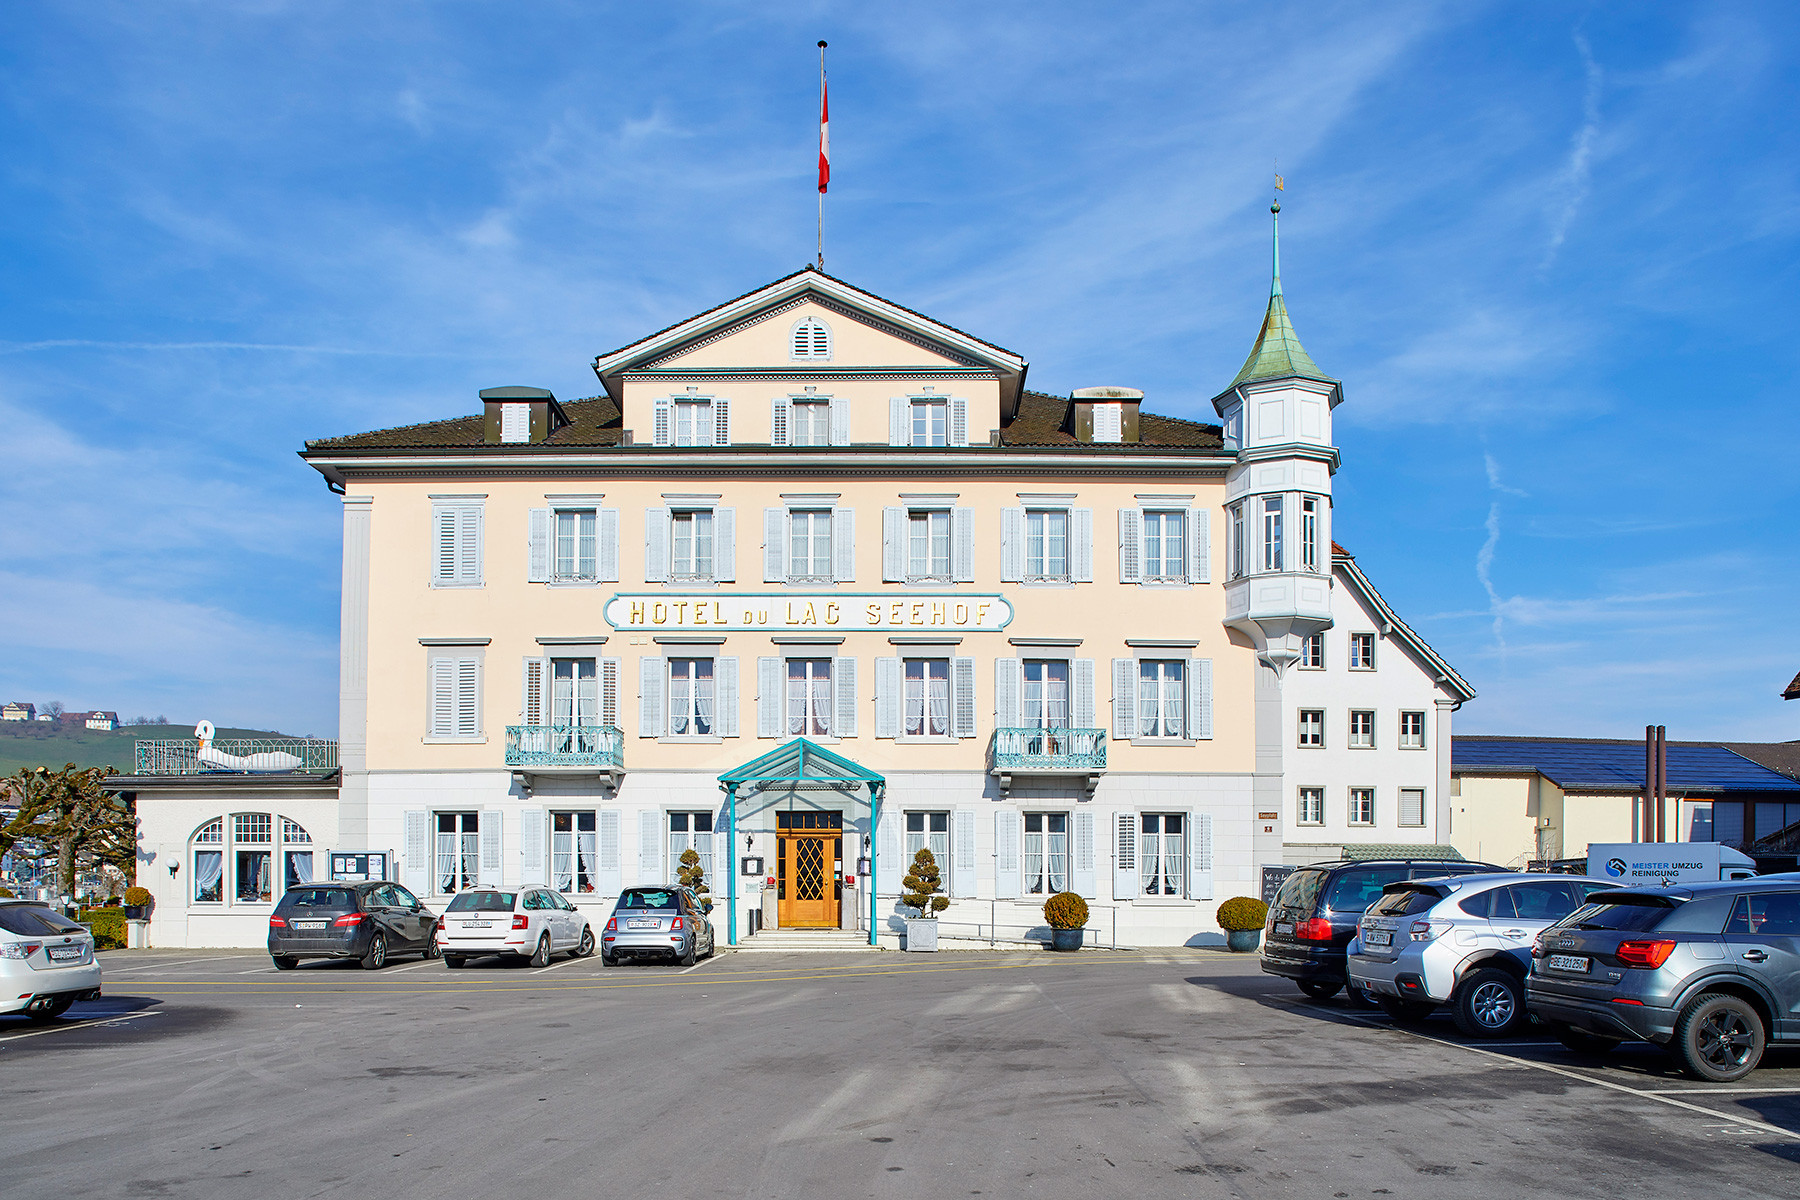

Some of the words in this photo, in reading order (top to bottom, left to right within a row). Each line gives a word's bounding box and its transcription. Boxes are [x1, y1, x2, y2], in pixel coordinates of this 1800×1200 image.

[629, 601, 728, 625] HOTEL
[785, 601, 840, 625] LAC
[866, 601, 991, 626] SEEHOF
[1631, 862, 1670, 870] MEISTER
[1671, 862, 1704, 870] UMZUG
